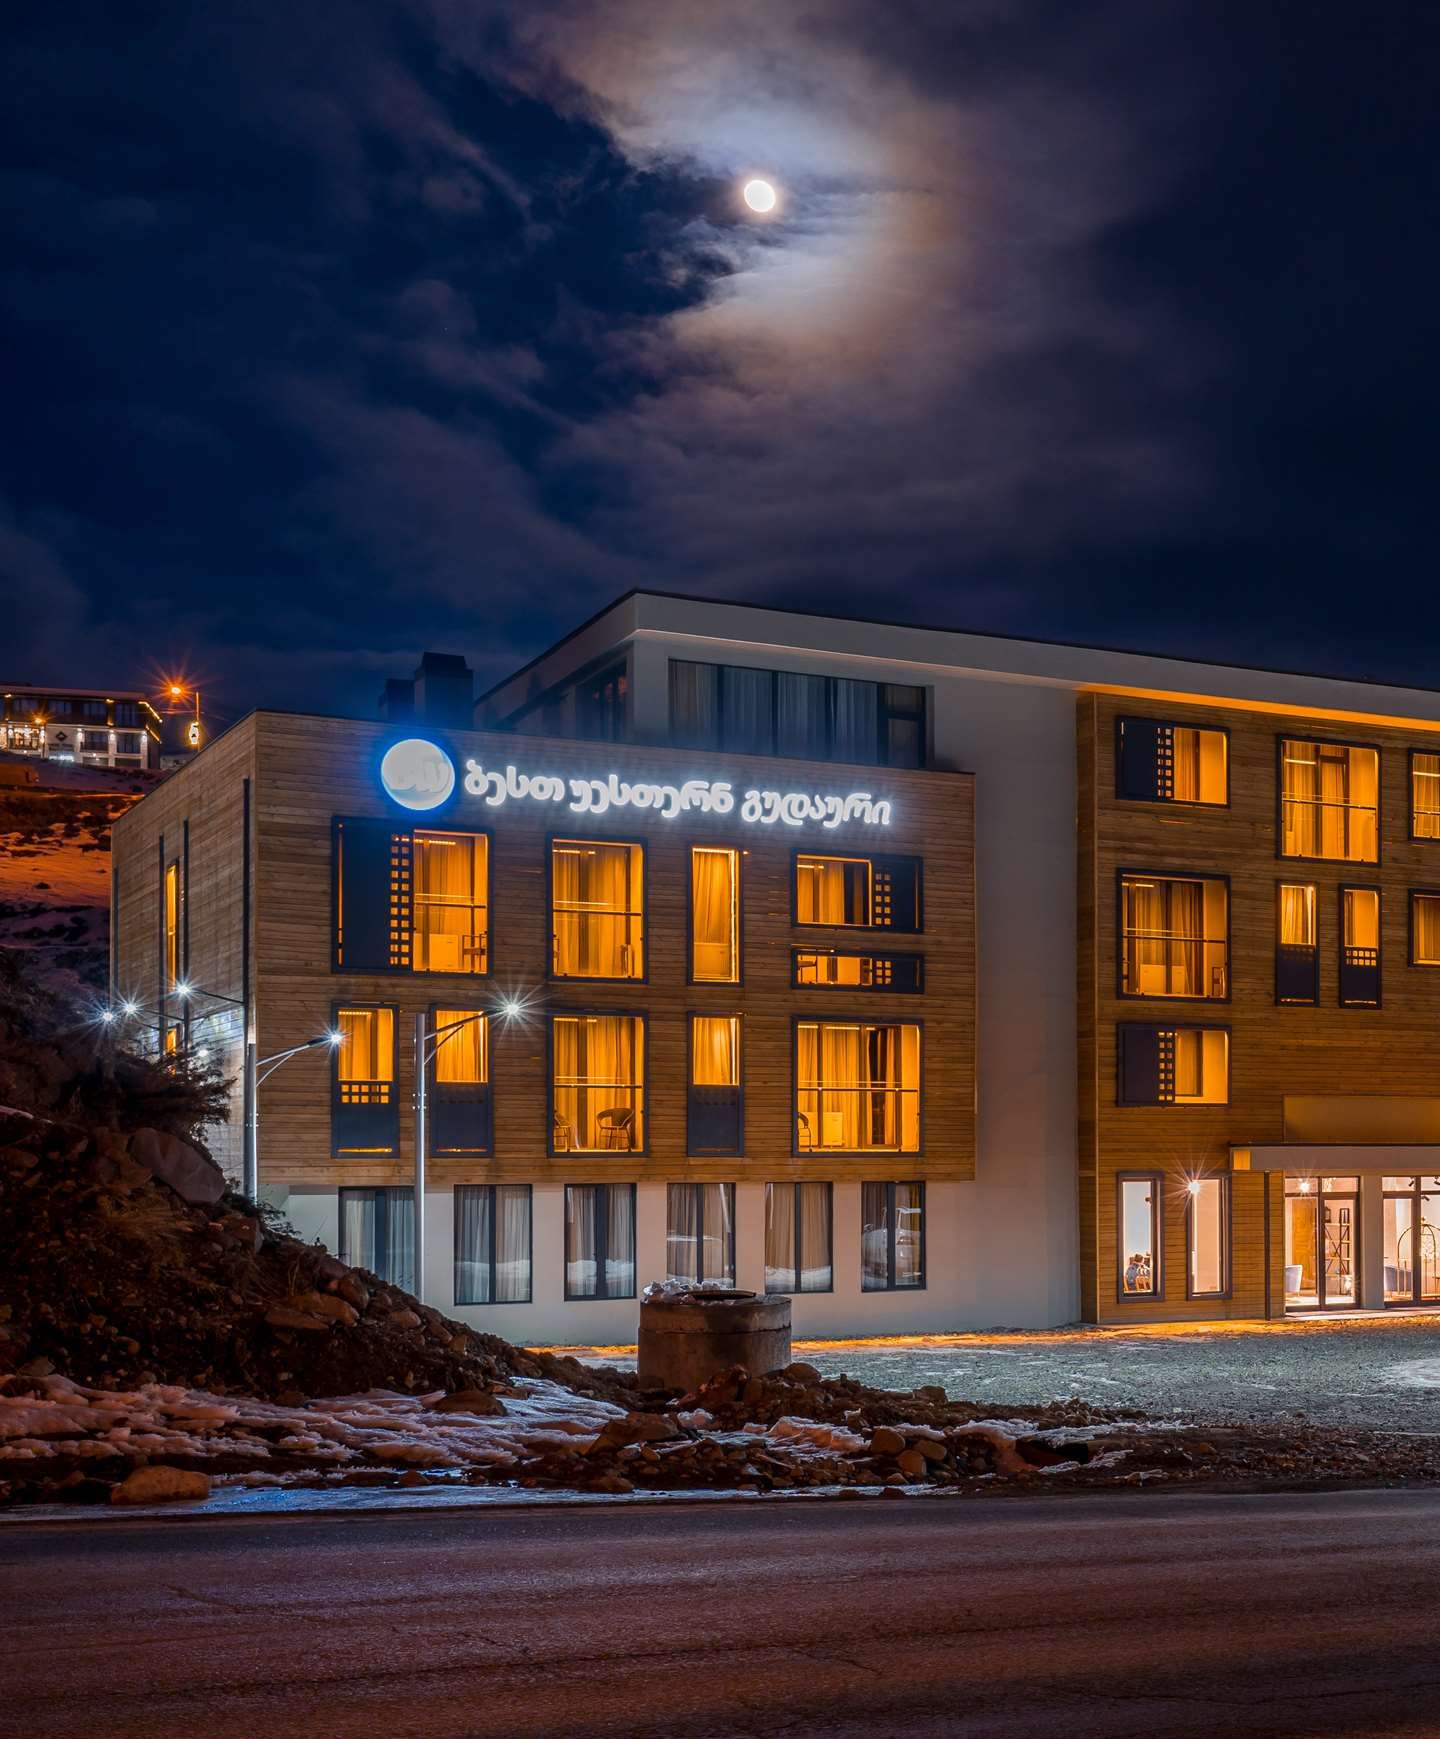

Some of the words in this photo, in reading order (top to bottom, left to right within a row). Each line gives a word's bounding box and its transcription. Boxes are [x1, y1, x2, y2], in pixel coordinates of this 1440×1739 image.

[464, 759, 565, 806] ბესთ
[569, 774, 735, 818] უესთერნ
[741, 789, 891, 829] გუდაური
